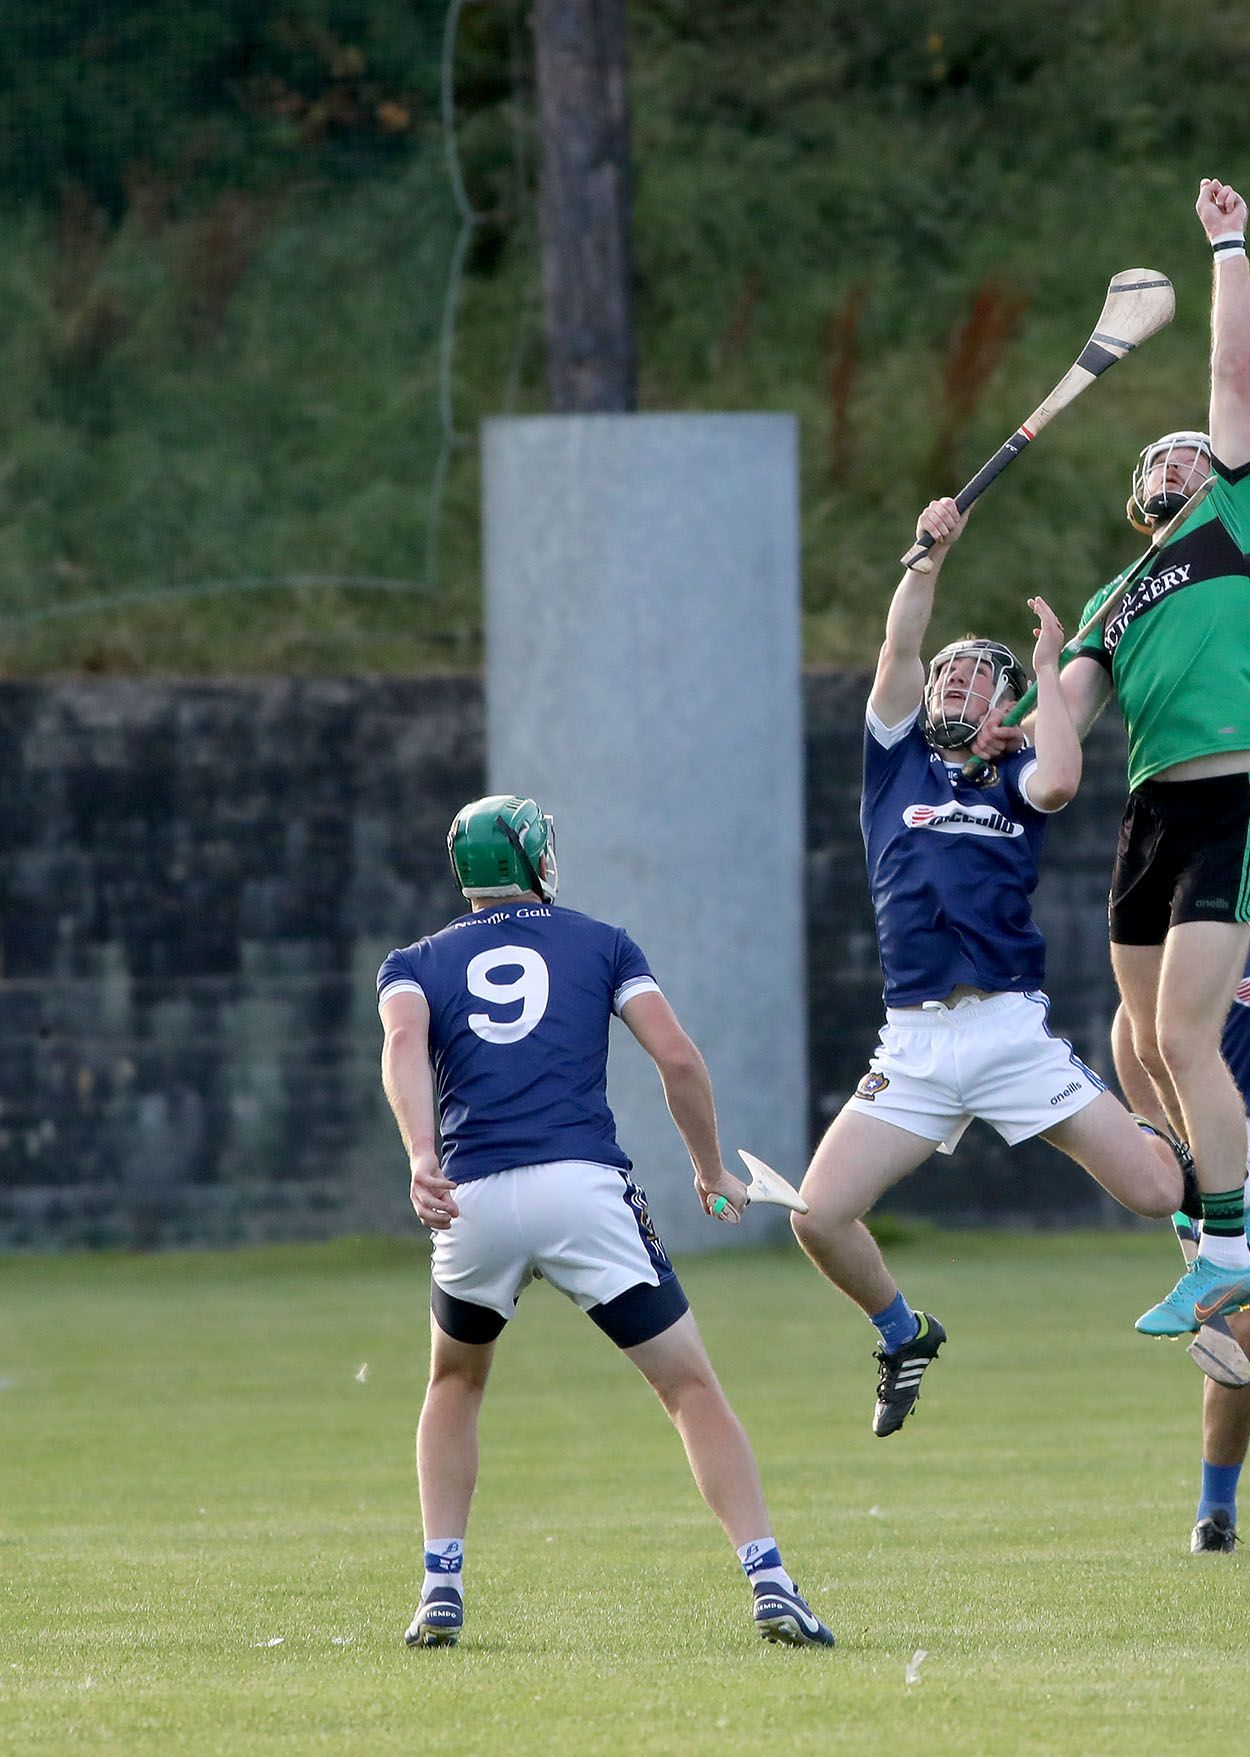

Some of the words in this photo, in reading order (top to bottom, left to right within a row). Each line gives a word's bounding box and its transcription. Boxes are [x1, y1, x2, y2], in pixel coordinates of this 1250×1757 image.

[516, 908, 552, 919] Gall
[466, 944, 550, 1045] 9
[1050, 1081, 1083, 1106] oneills
